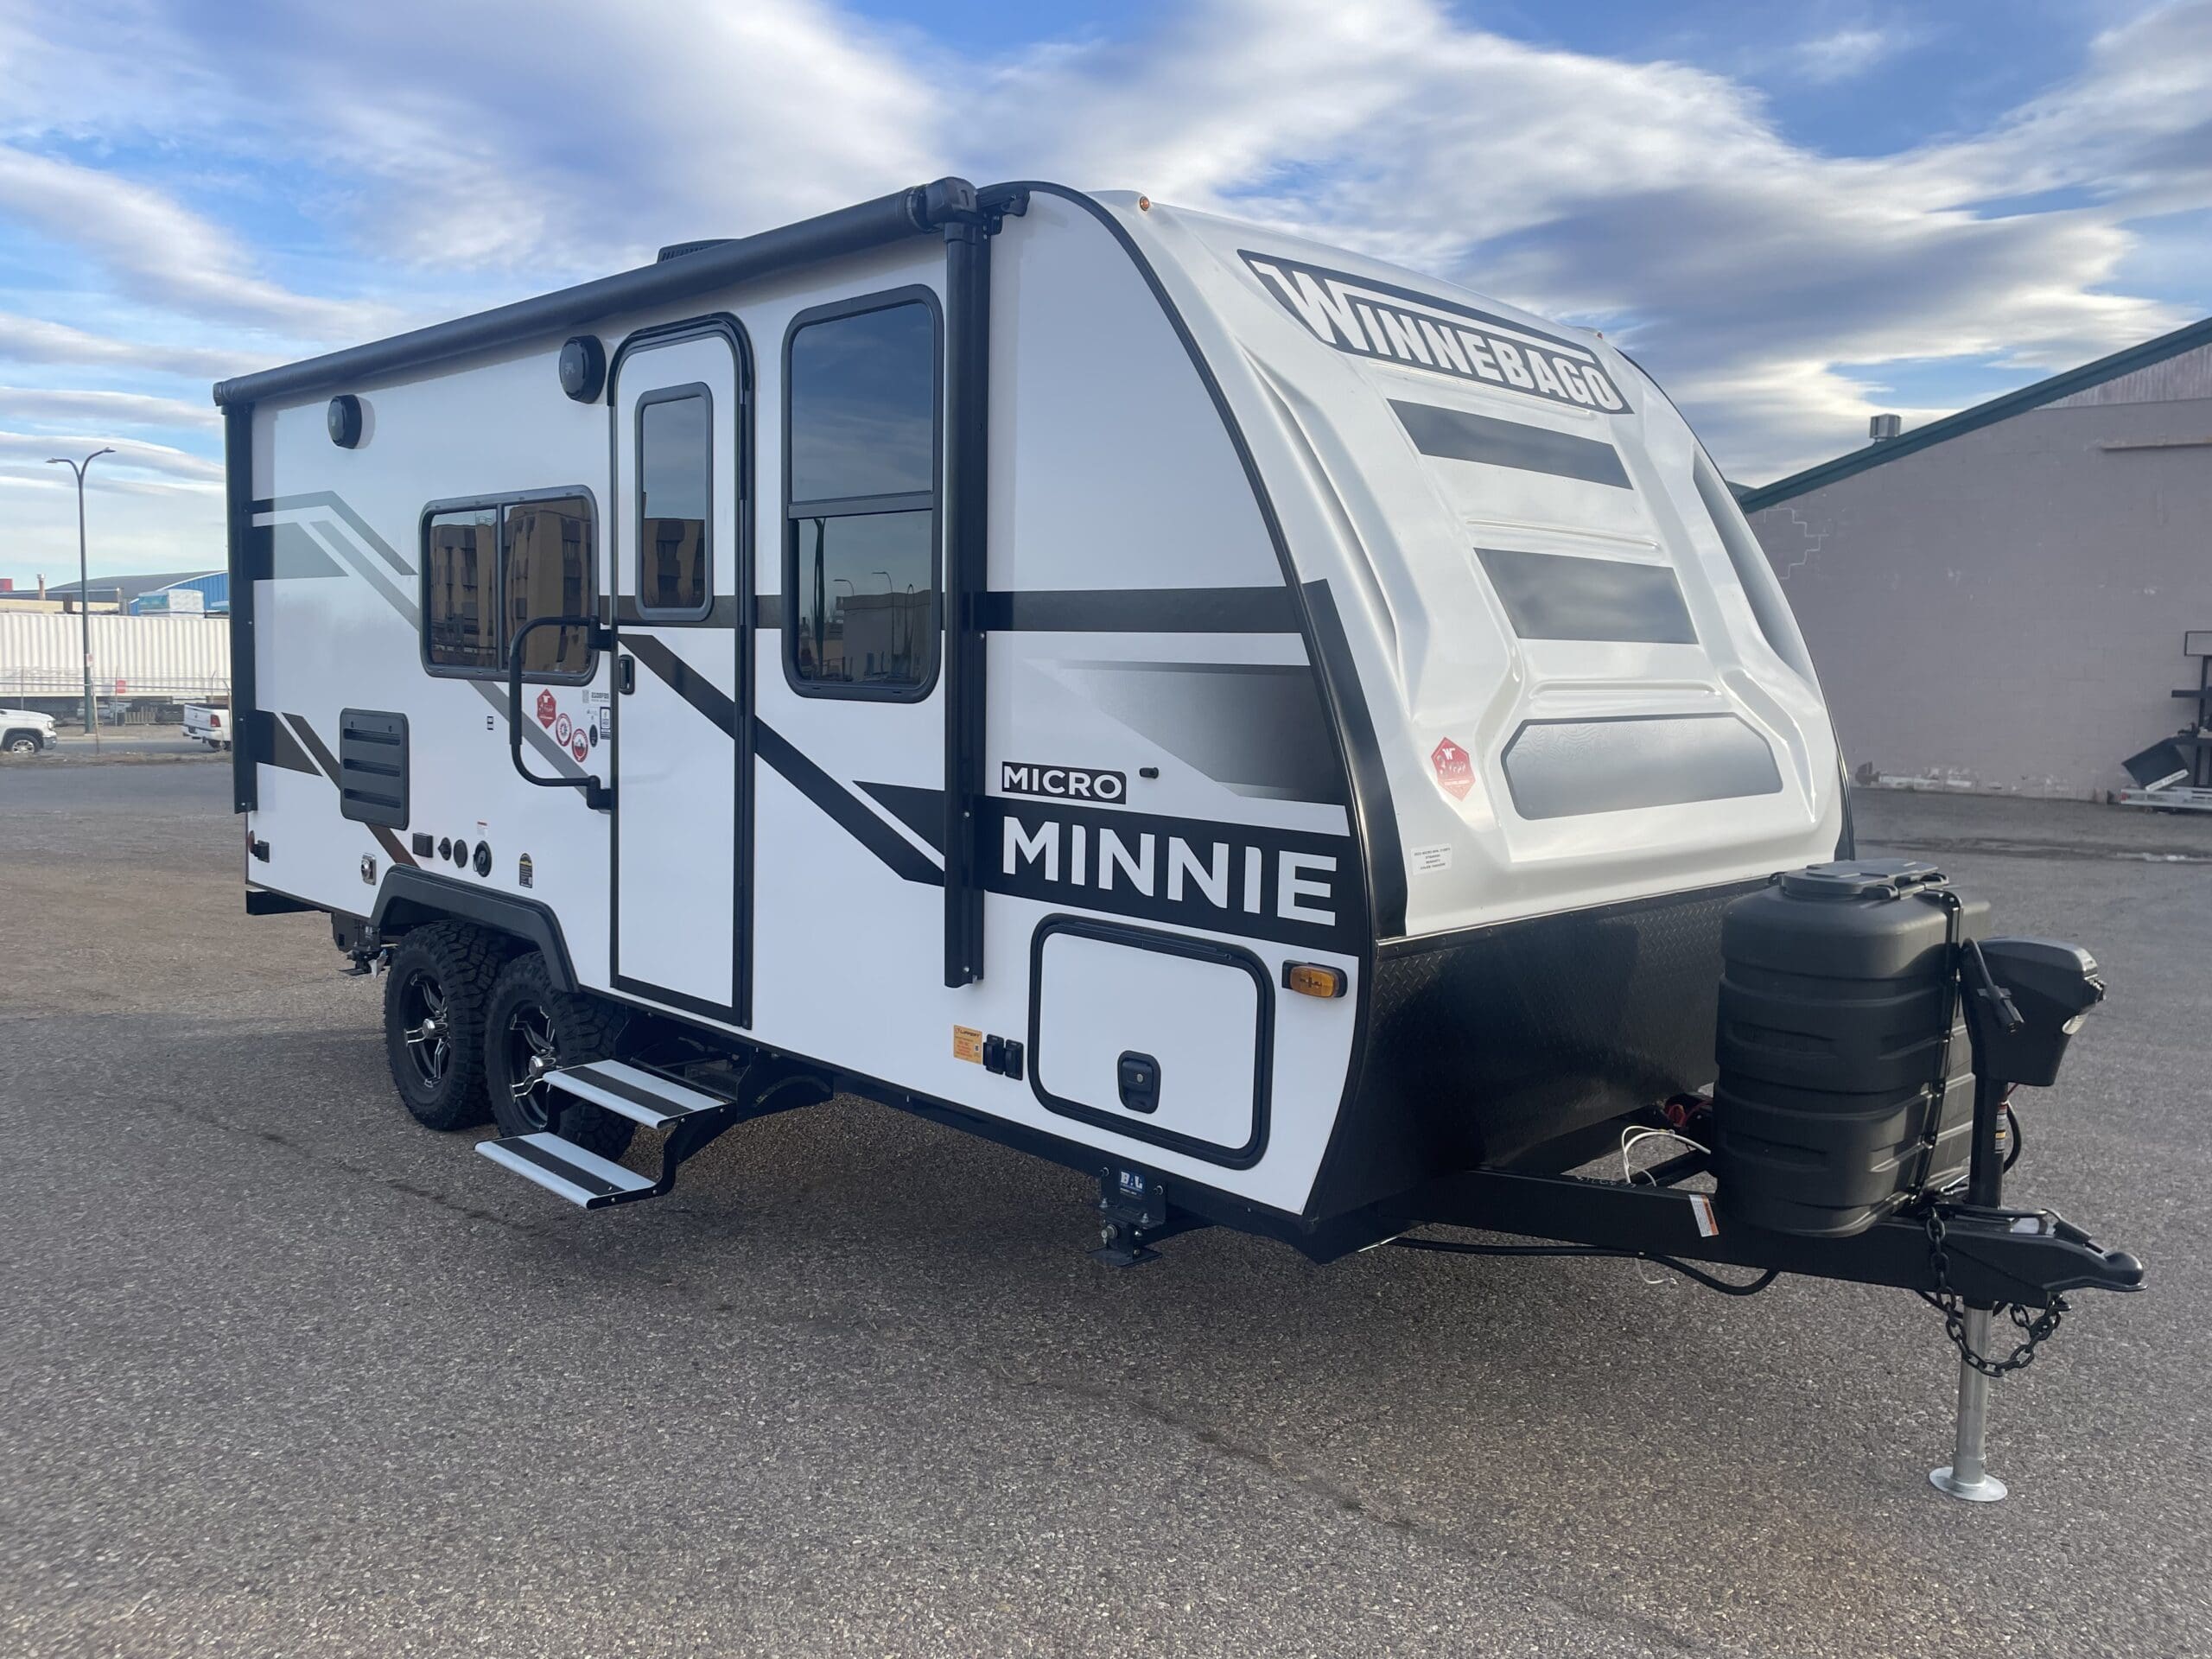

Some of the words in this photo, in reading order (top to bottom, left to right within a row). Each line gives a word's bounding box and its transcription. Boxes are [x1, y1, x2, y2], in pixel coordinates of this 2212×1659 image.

[1249, 259, 1623, 410] WINNEBAGO
[1003, 766, 1122, 799] MICRO
[1002, 816, 1337, 926] MINNIE
